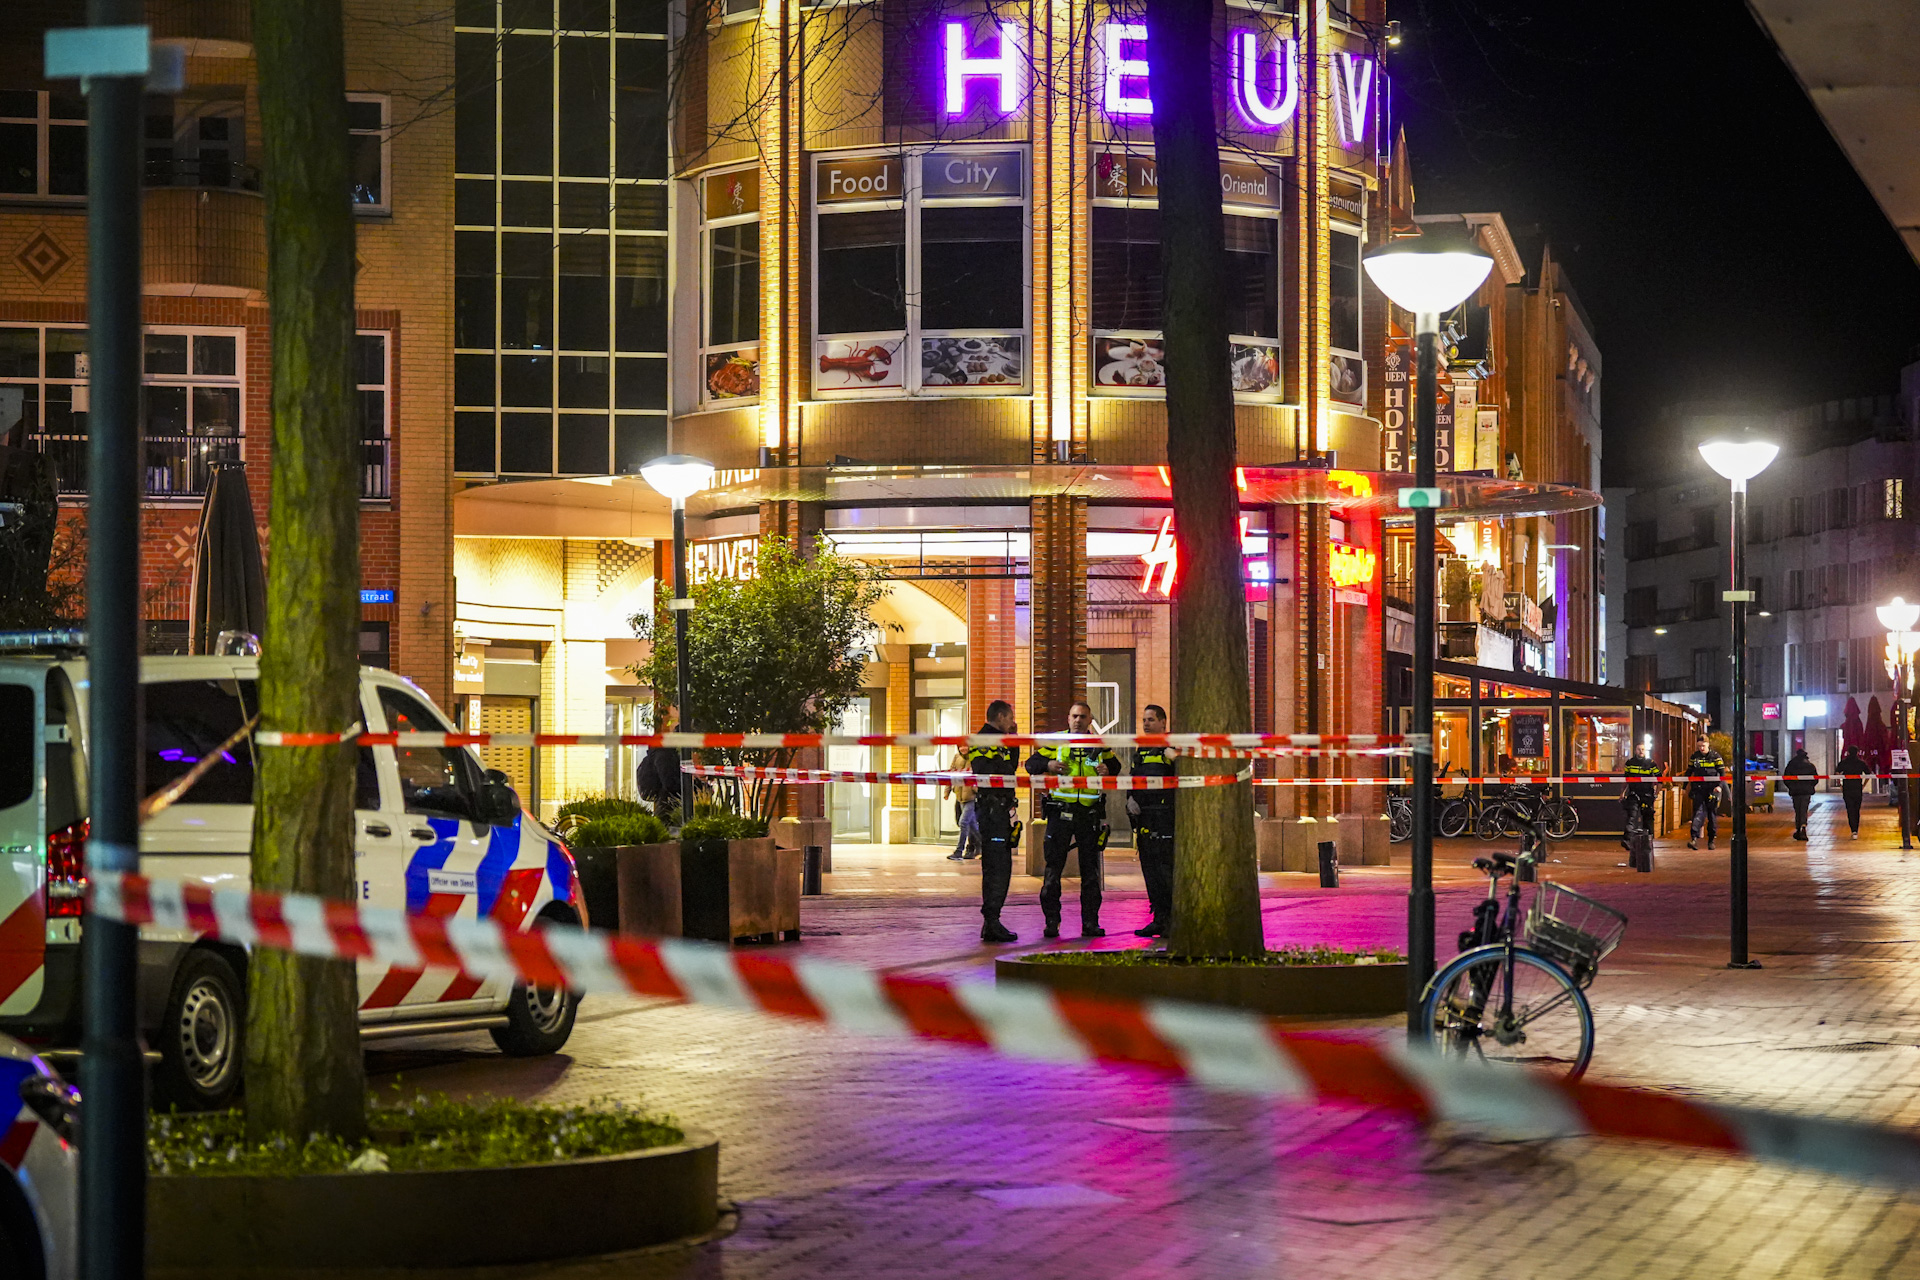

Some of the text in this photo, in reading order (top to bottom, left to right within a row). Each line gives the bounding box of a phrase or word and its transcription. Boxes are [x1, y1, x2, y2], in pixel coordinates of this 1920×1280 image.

[829, 159, 998, 195] Food City
[1221, 173, 1268, 197] Oriental
[1436, 415, 1452, 425] EEN
[361, 593, 389, 601] straat
